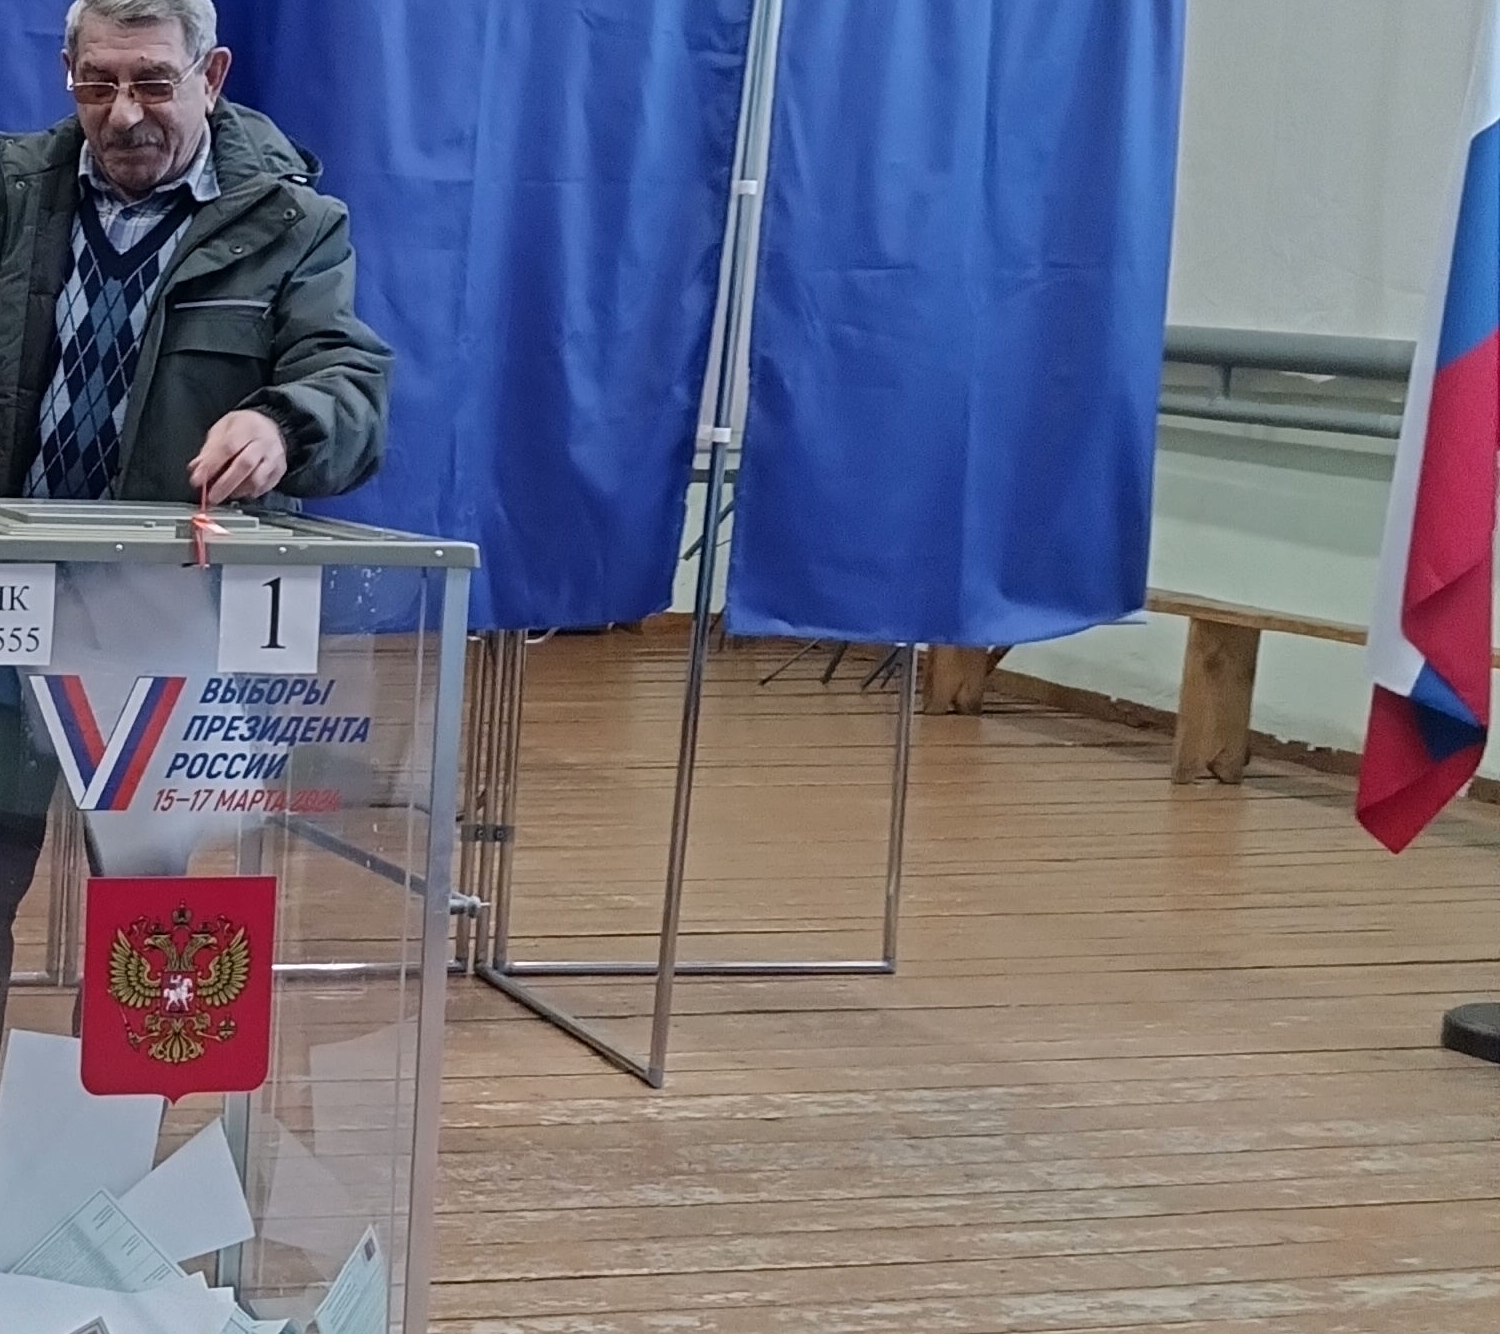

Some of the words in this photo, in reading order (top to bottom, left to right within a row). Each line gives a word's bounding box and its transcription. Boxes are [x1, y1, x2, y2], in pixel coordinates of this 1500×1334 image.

[260, 577, 286, 650] 1
[199, 678, 335, 706] ВЫБОРЫ
[182, 715, 371, 746] ПРЕЗИДЕНТА
[165, 753, 289, 780] РОССИИ
[213, 789, 287, 812] МАРТА
